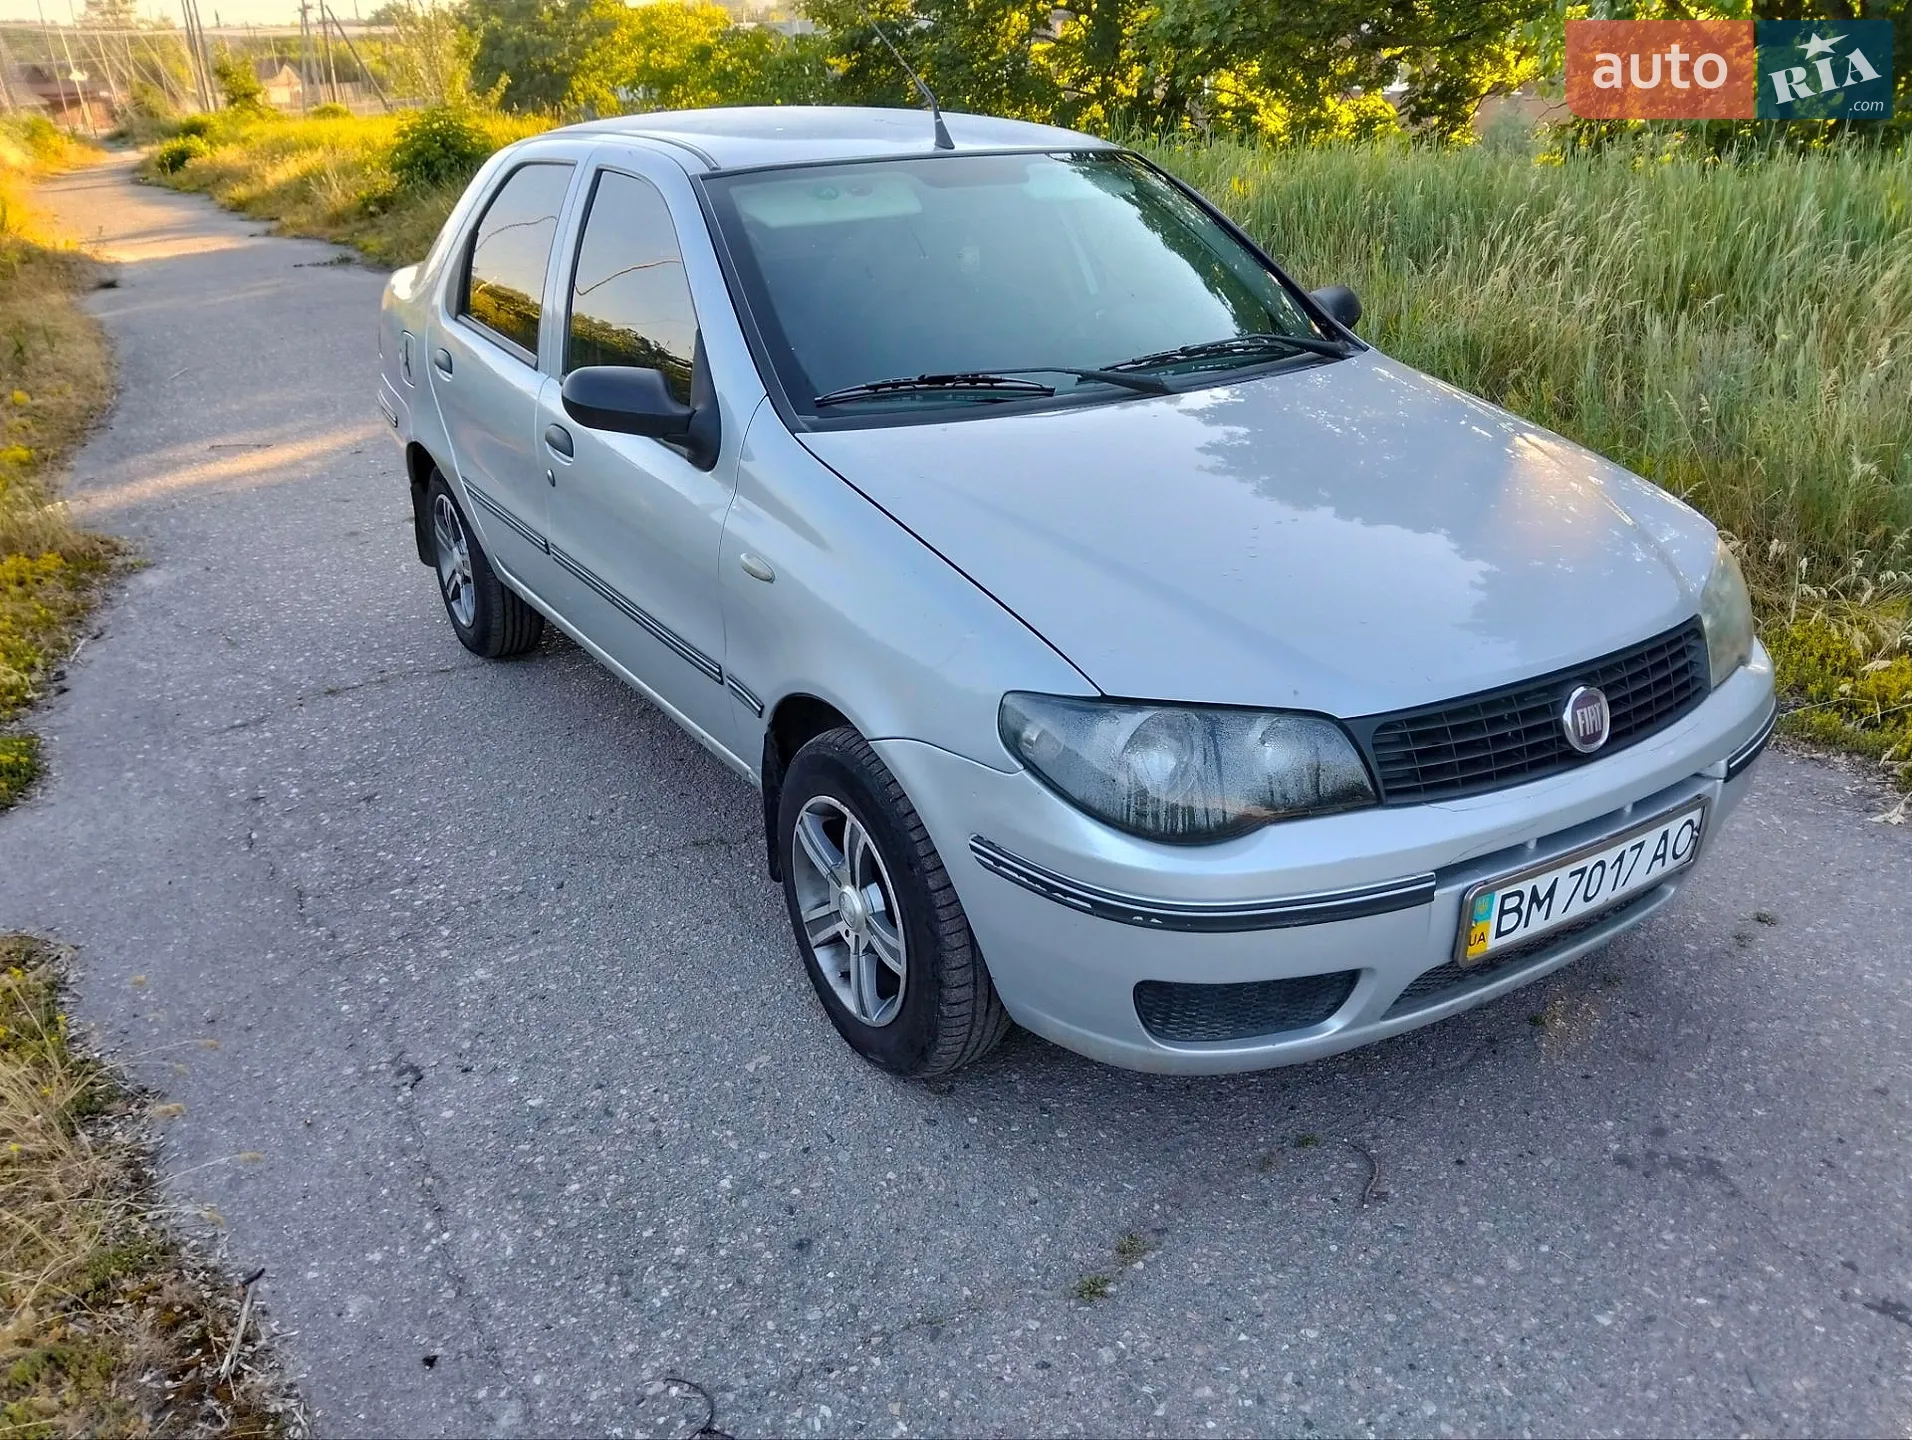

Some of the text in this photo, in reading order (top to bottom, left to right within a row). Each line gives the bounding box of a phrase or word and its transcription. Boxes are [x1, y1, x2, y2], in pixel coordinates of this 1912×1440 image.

[1576, 702, 1602, 737] FIAT
[1495, 819, 1695, 939] BM 7017 AO
[1469, 932, 1486, 947] UA
